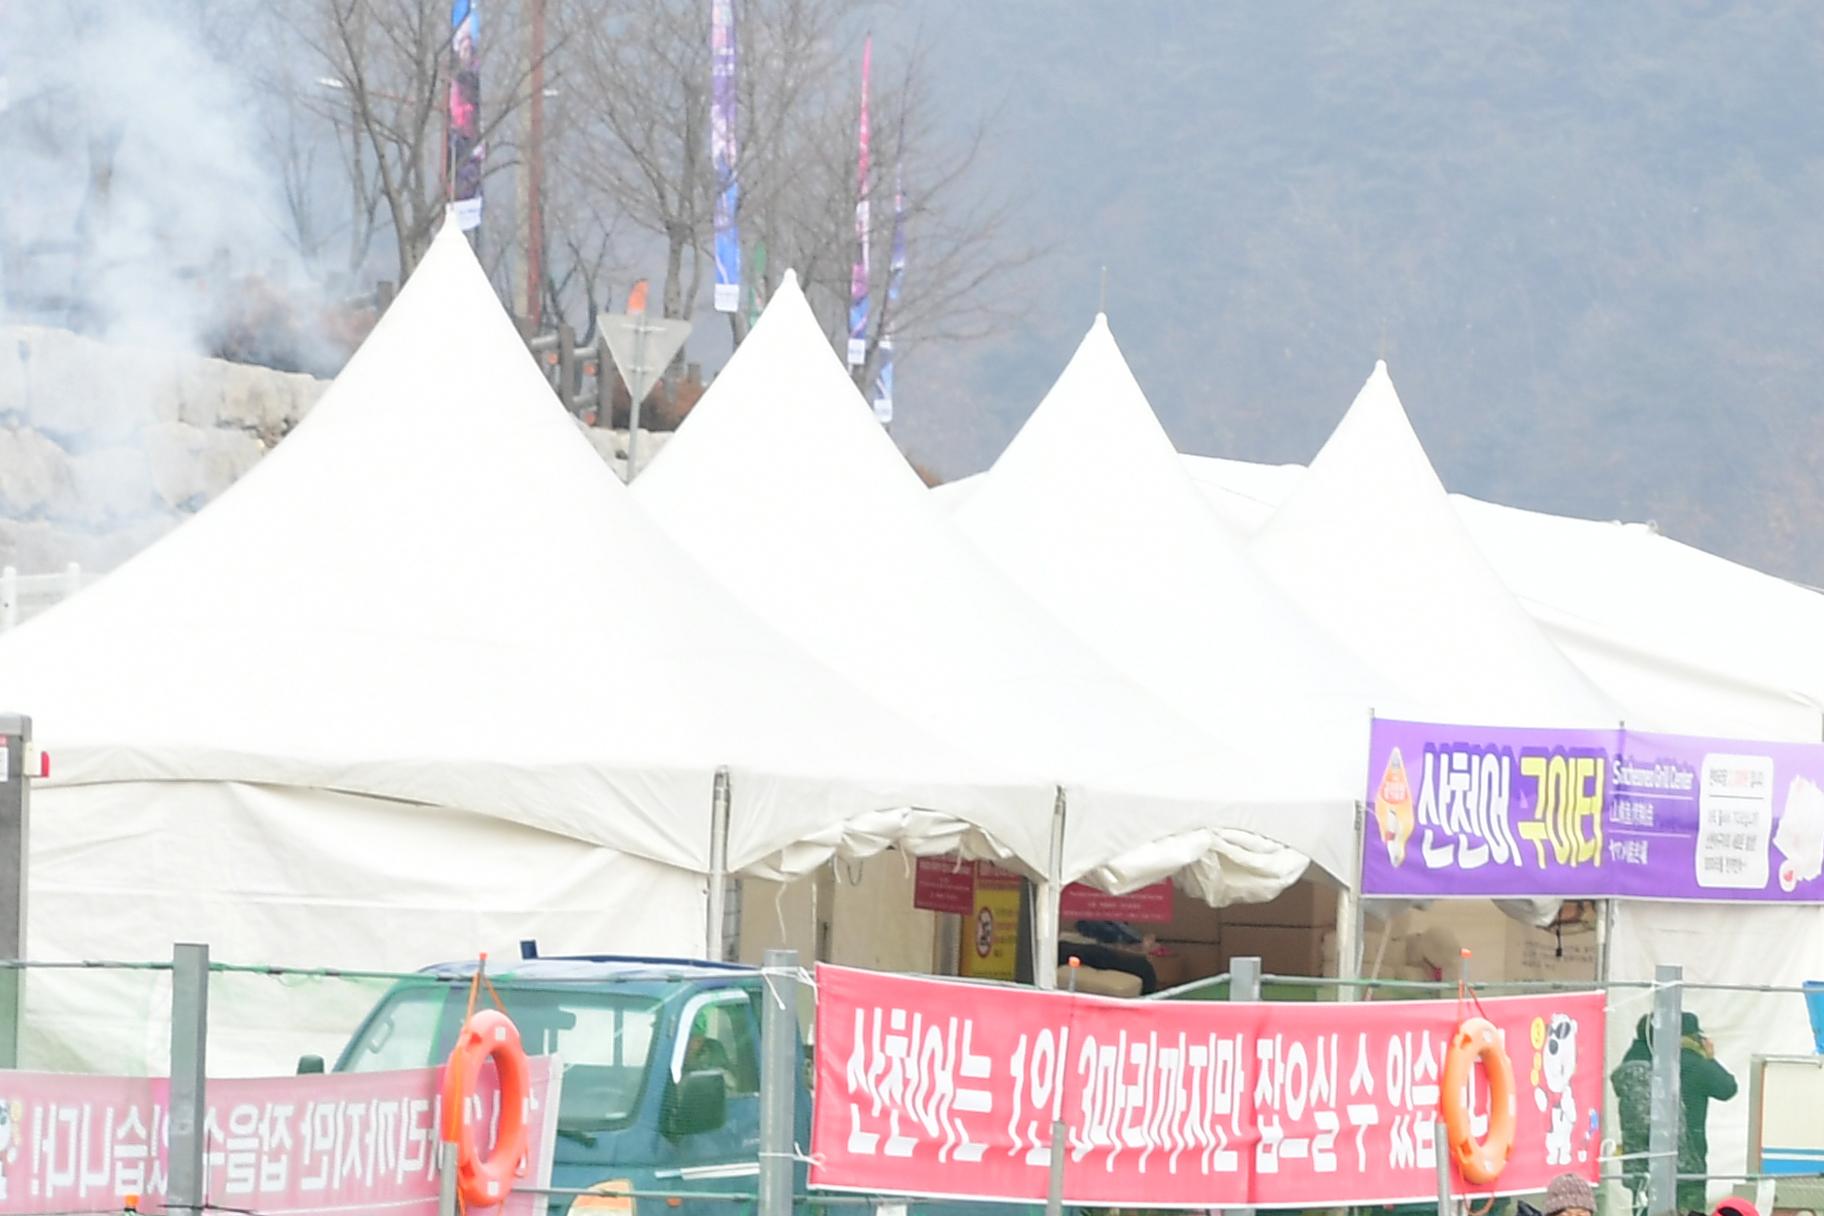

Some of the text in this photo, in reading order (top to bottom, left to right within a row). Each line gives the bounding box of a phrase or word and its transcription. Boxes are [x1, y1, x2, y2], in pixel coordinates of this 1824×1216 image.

[1418, 751, 1604, 869] 산천어 구이터
[847, 1007, 993, 1164] 산천어는
[1008, 1027, 1068, 1166] 1인
[1254, 1033, 1340, 1174] 잡으실
[1347, 1033, 1380, 1173] 수
